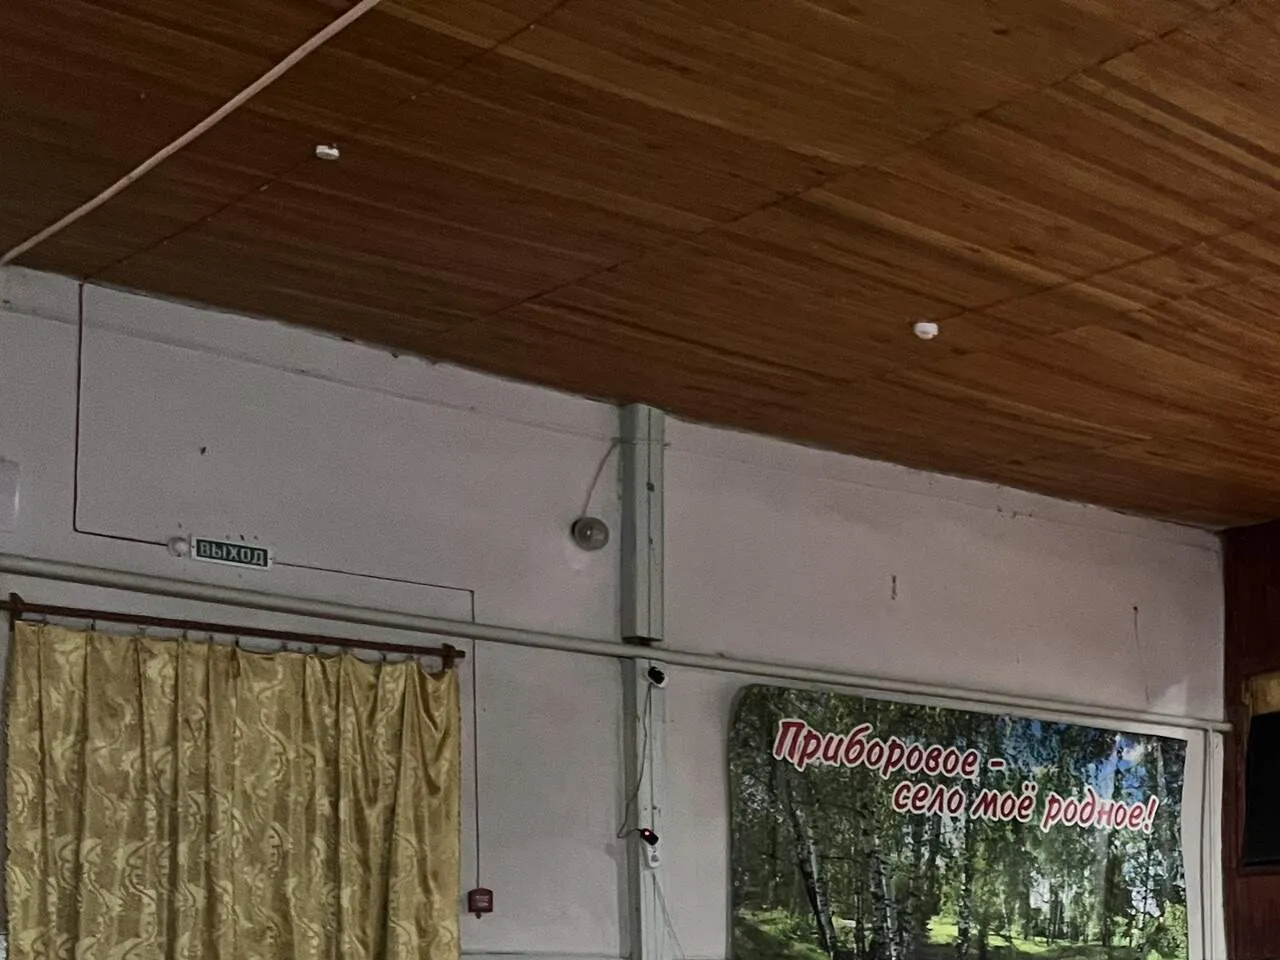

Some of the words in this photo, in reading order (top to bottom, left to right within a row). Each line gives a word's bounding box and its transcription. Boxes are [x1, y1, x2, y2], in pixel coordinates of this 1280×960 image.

[200, 541, 265, 567] ВЫХОД
[774, 719, 979, 779] Приборовое
[894, 782, 966, 815] село
[971, 782, 1037, 822] моё
[1041, 783, 1158, 832] родное!
